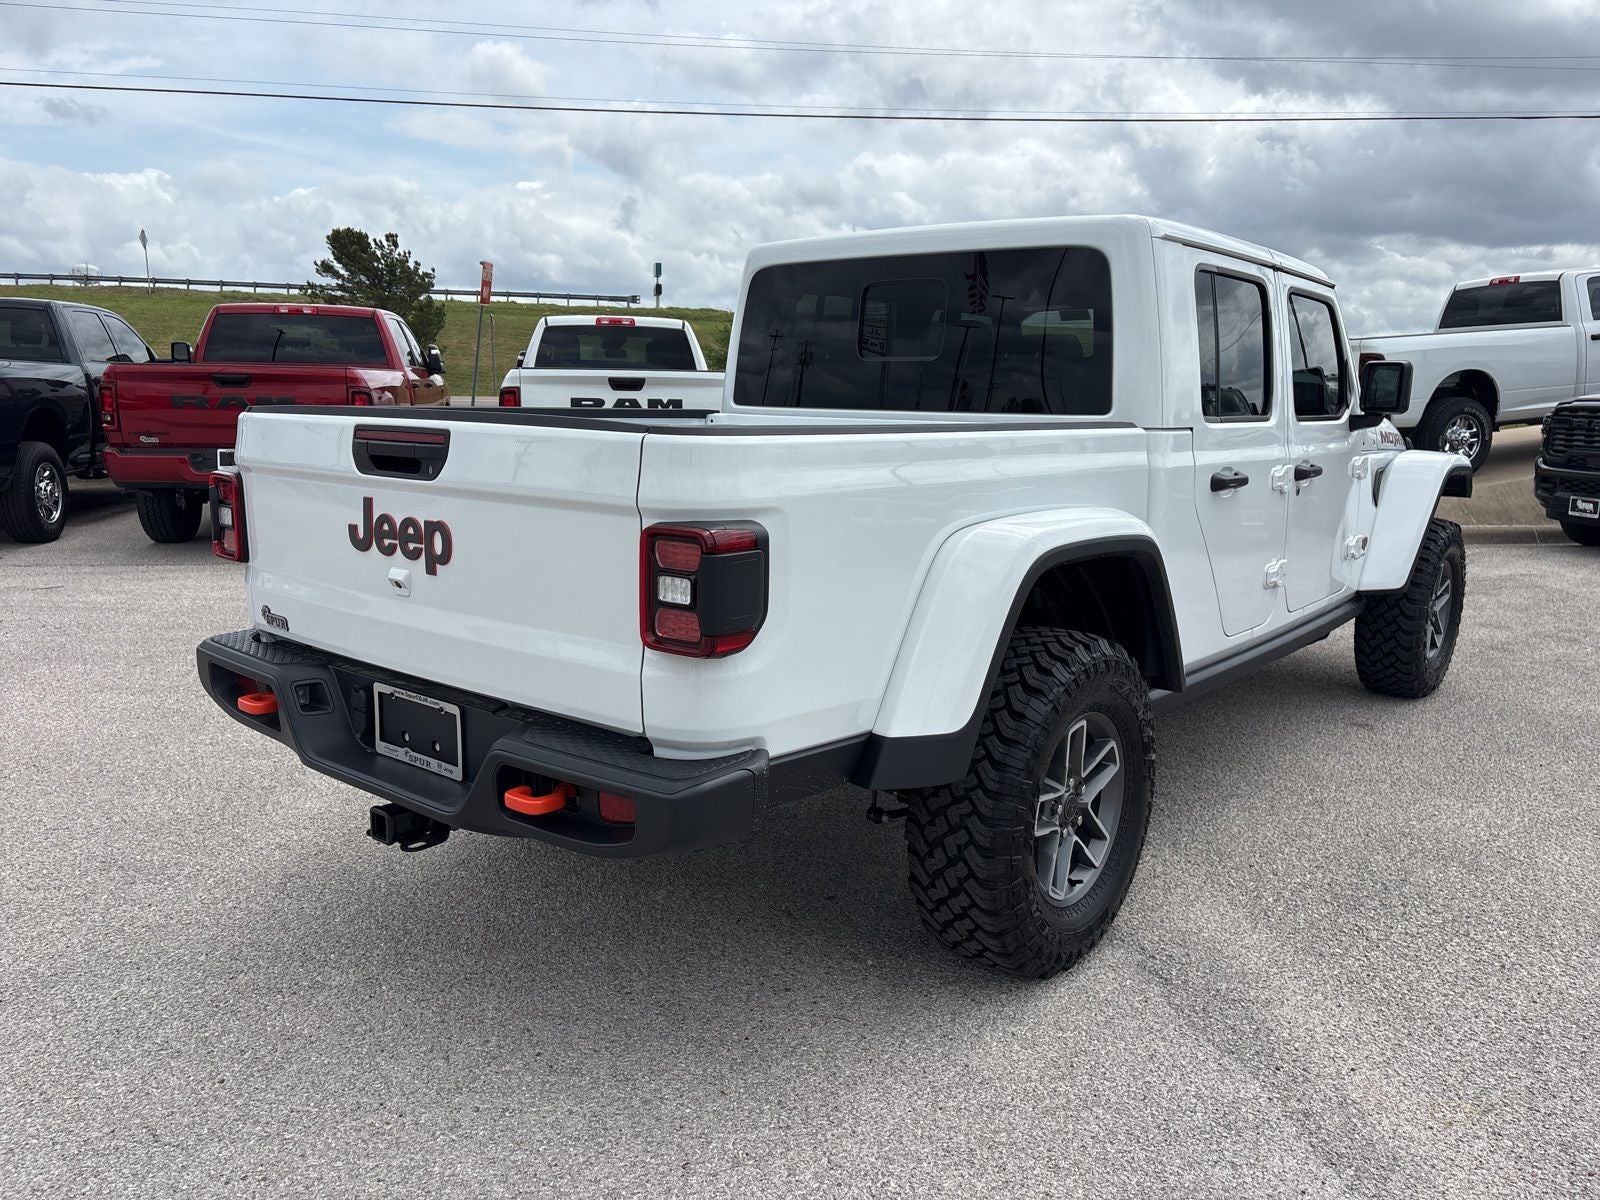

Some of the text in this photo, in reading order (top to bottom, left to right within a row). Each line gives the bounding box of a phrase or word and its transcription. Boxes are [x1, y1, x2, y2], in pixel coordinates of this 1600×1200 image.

[347, 496, 453, 576] Jeep
[266, 613, 288, 630] SPUR
[408, 754, 432, 769] SPUR
